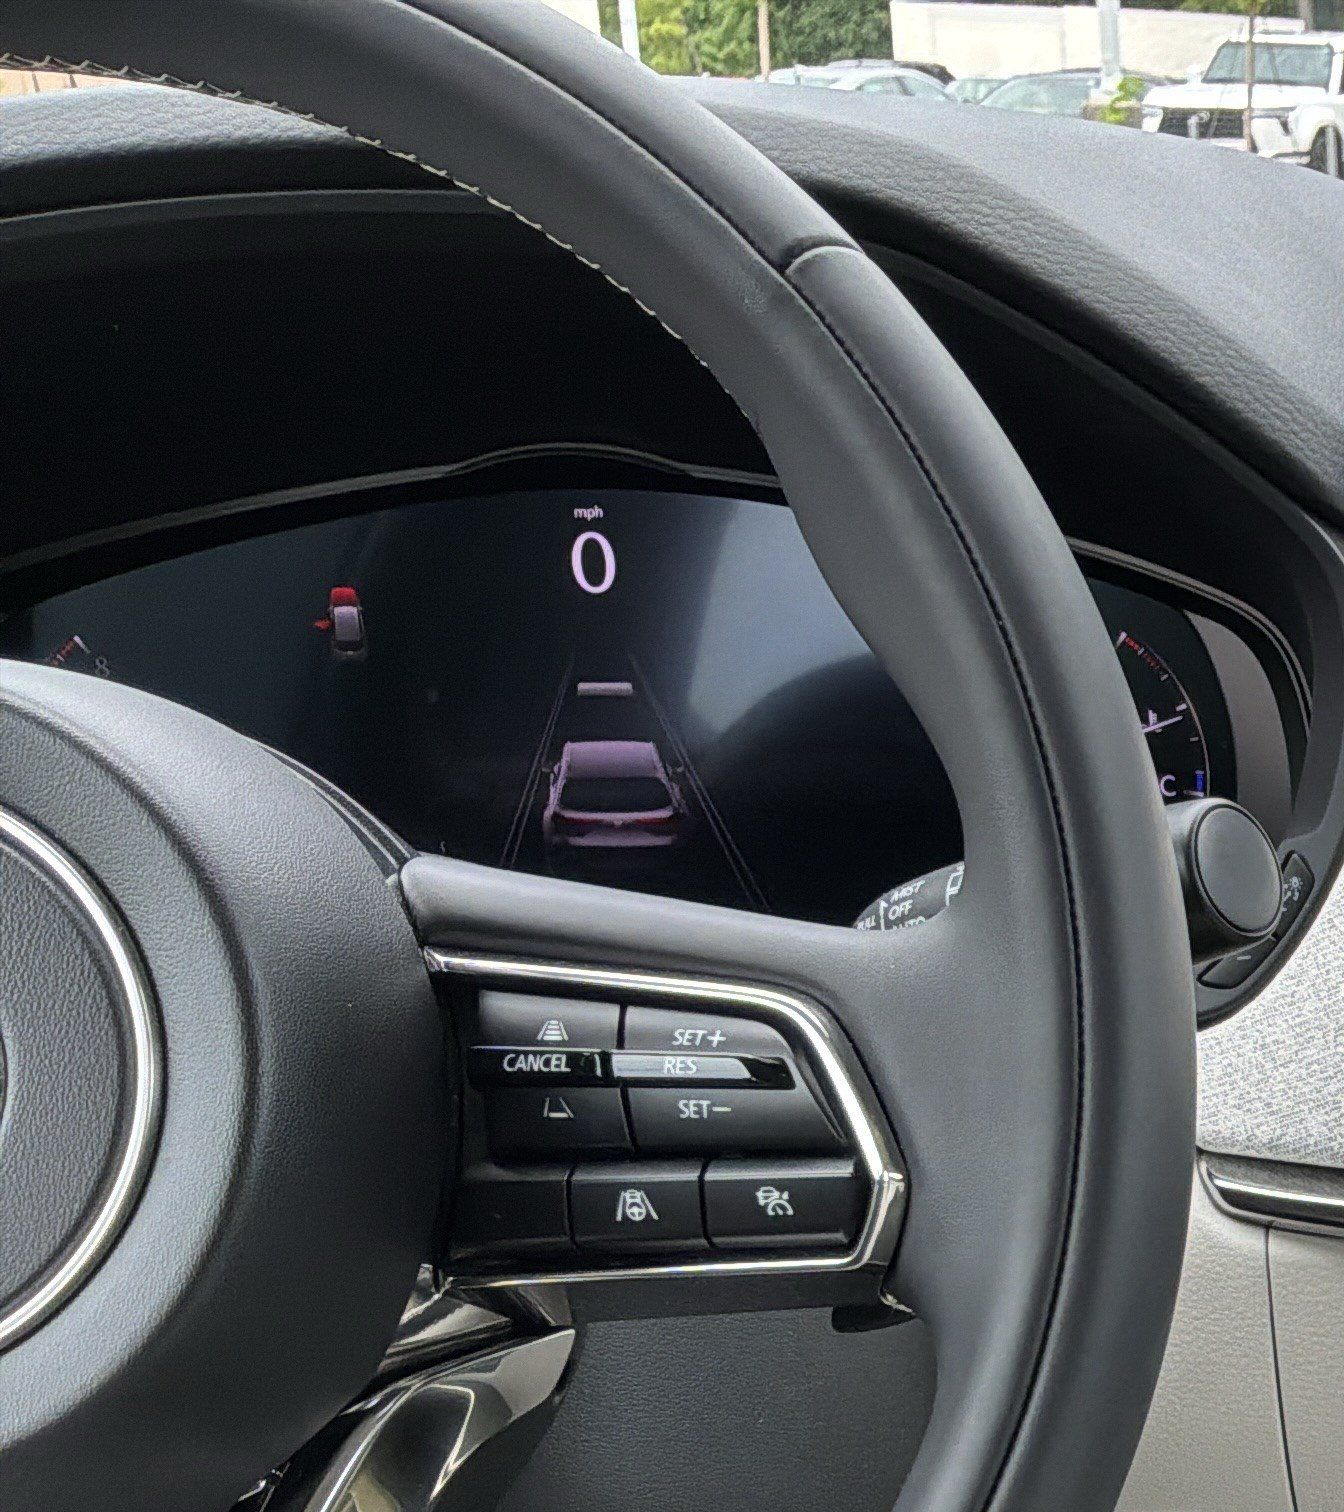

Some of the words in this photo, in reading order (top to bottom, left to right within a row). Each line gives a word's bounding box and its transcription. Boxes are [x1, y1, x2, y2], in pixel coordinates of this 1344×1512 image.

[573, 504, 604, 522] mph
[571, 531, 616, 594] 0
[1158, 774, 1177, 798] C
[888, 899, 914, 921] OFF
[502, 1053, 572, 1073] CANCEL
[662, 1056, 698, 1076] RES
